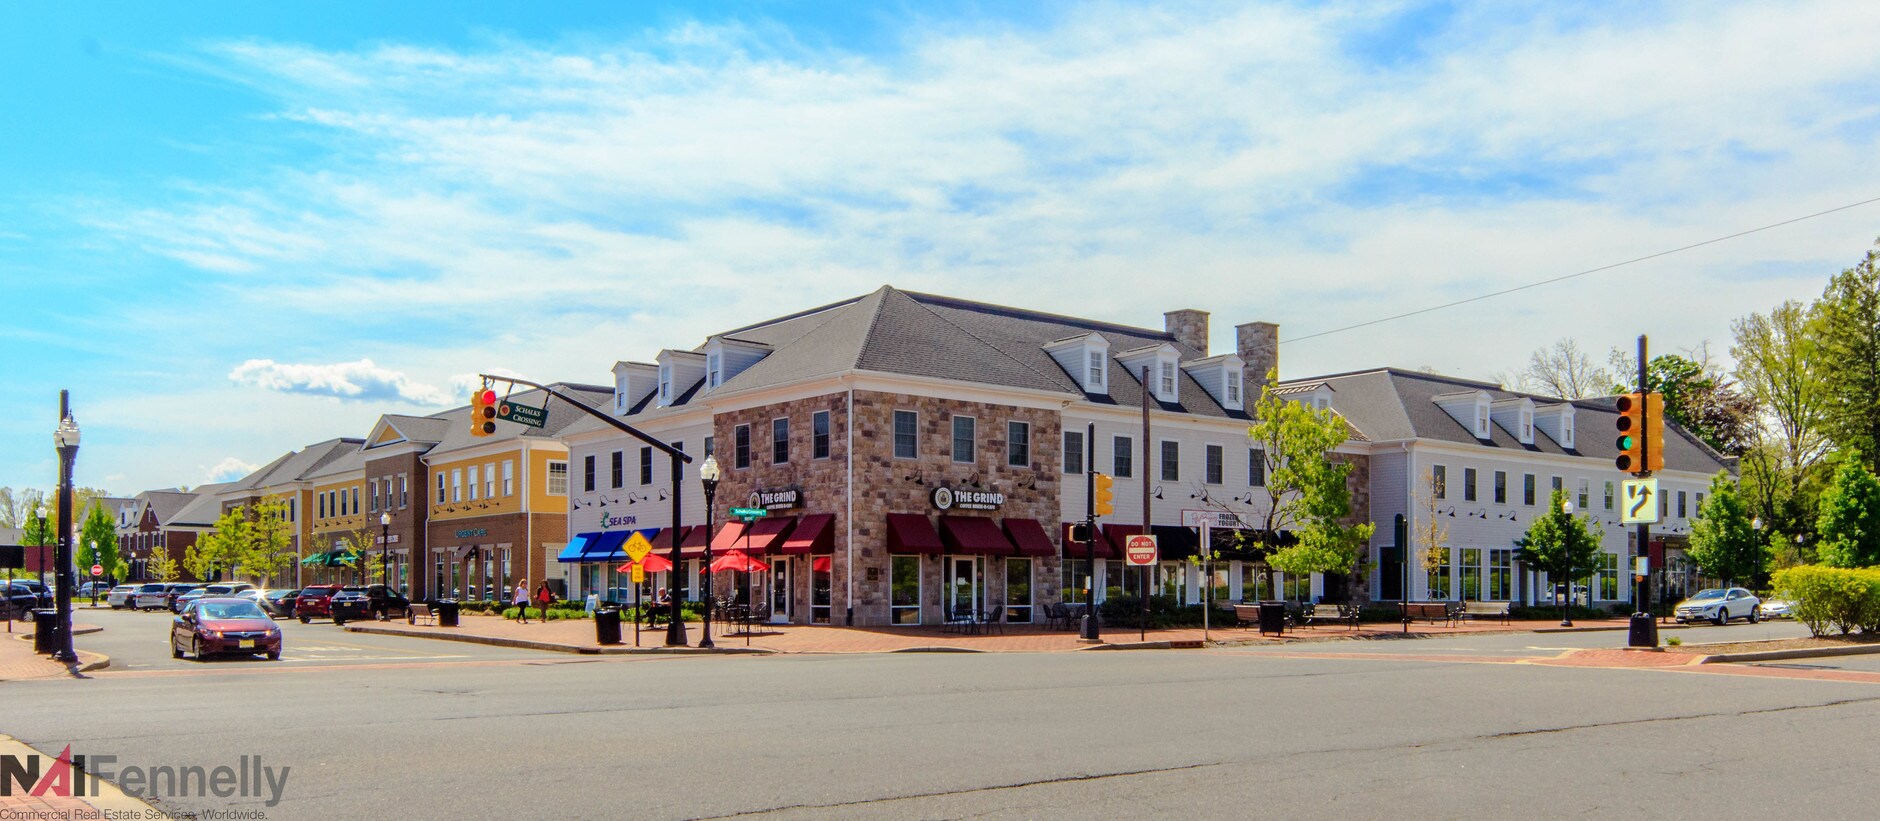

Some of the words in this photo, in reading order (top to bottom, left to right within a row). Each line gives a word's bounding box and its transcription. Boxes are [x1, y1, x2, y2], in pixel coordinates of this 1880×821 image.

[515, 405, 541, 417] SCHALKS
[512, 414, 541, 426] CROSSING
[761, 493, 774, 505] THE
[773, 490, 797, 503] GRIND
[954, 490, 973, 503] THE
[973, 492, 1004, 505] GRIND
[609, 516, 622, 526] SEA
[622, 515, 637, 526] SPA
